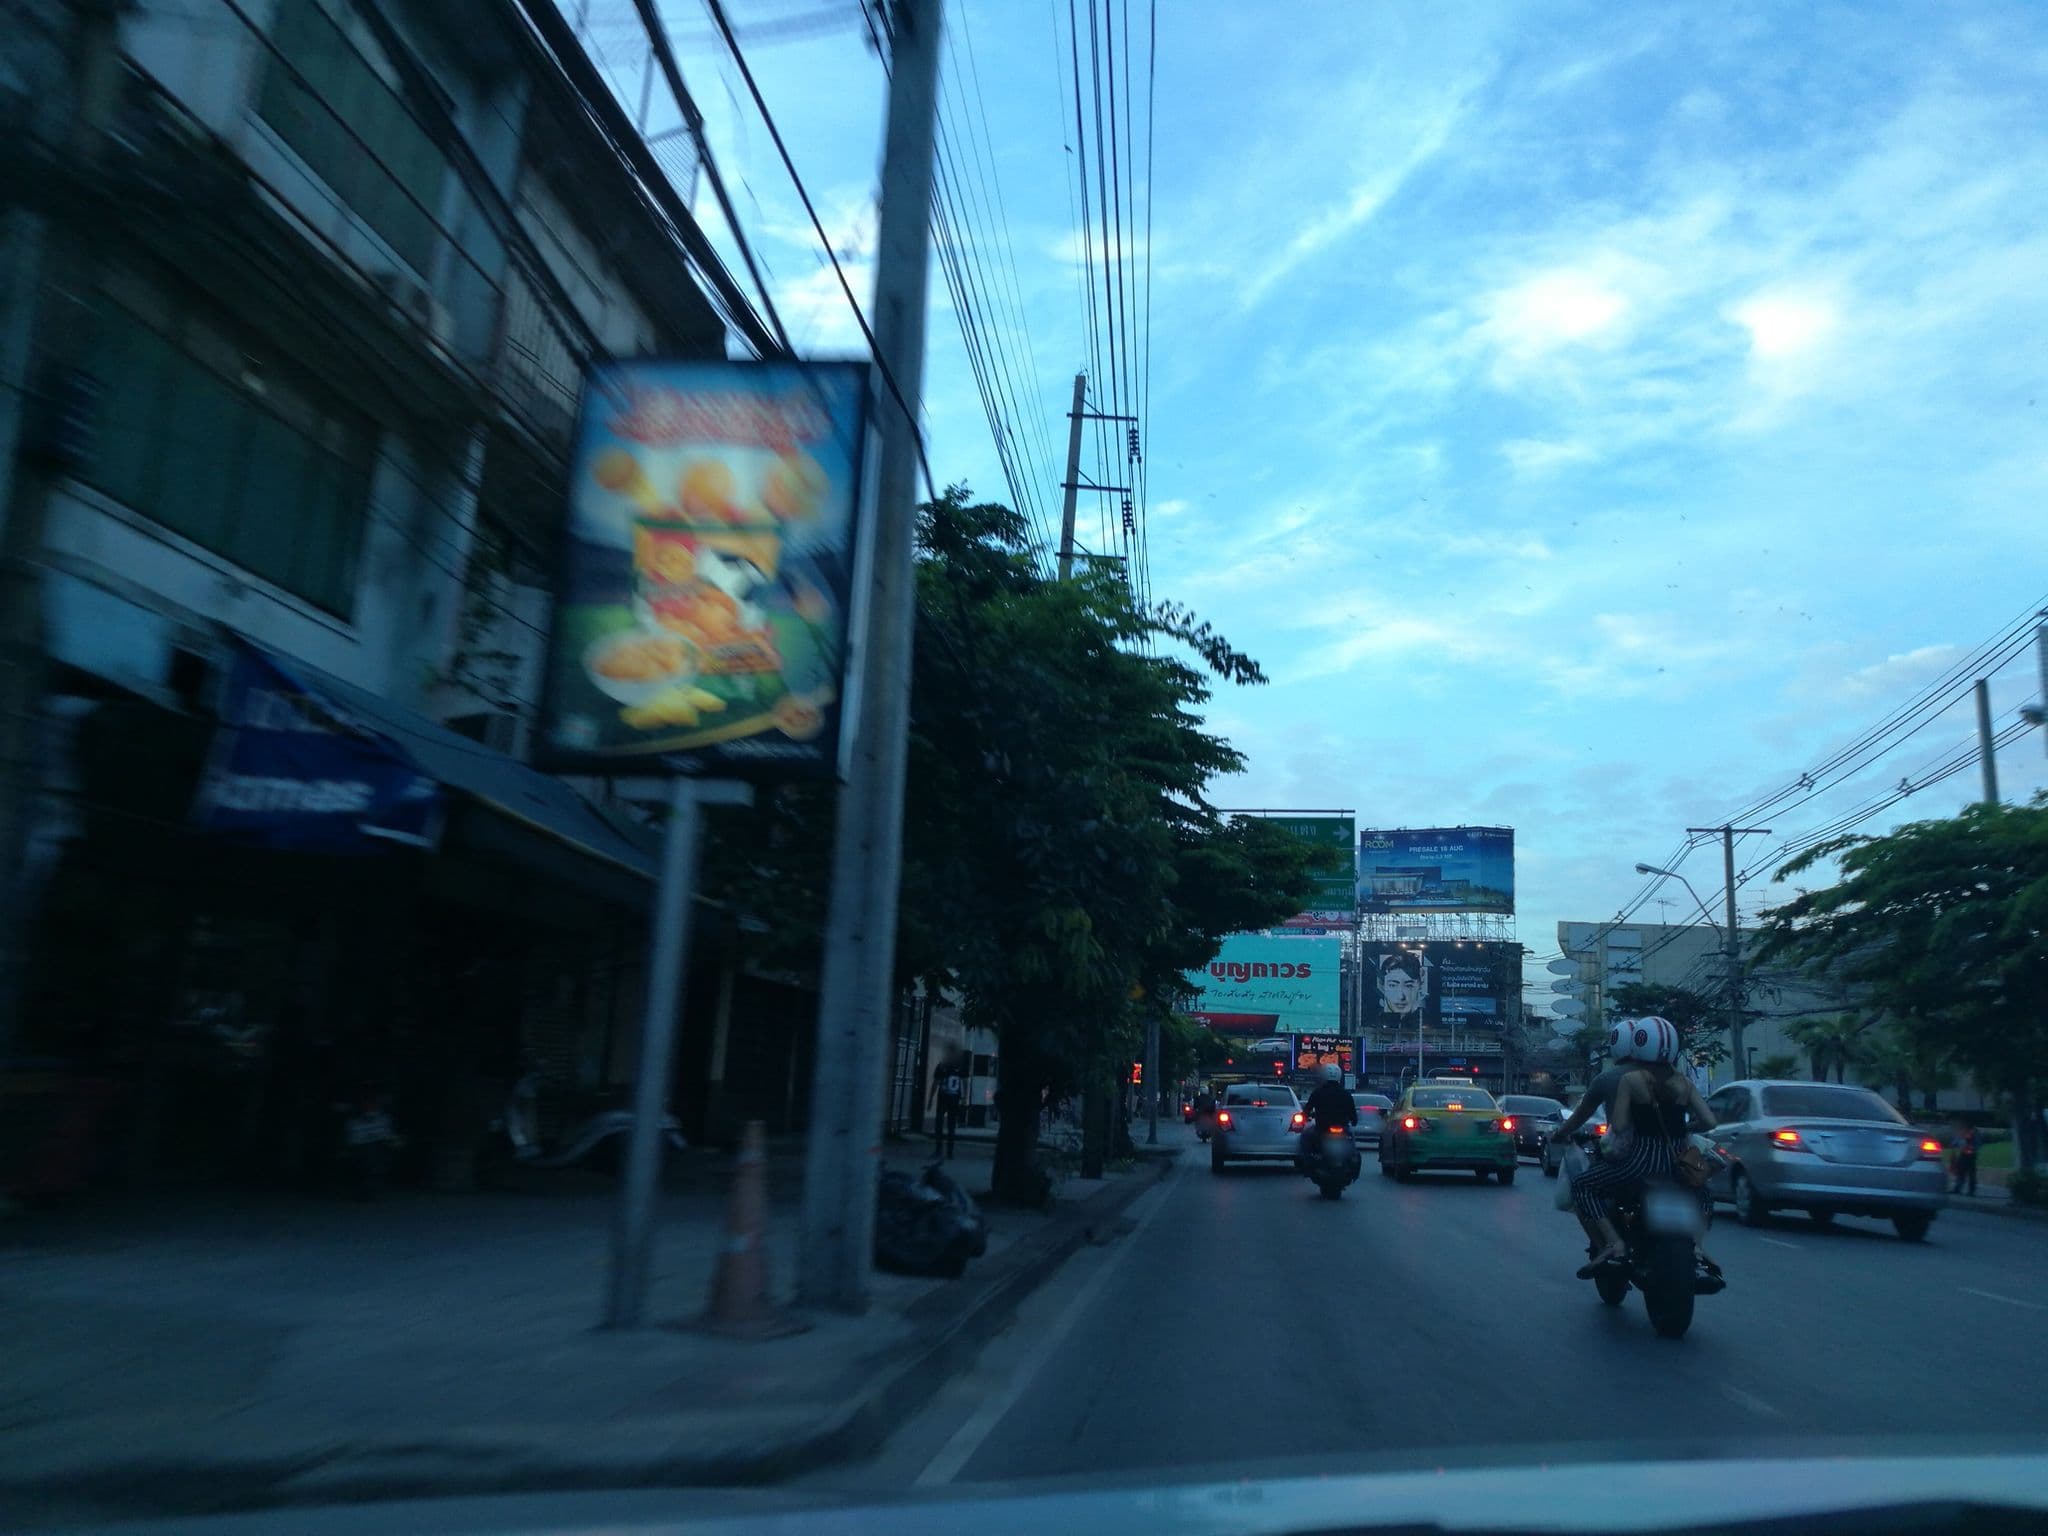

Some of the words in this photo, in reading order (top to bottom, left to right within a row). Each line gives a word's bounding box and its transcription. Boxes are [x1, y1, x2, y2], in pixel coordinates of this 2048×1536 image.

[1449, 844, 1464, 852] AUG
[1210, 962, 1312, 984] บุญถาวร
